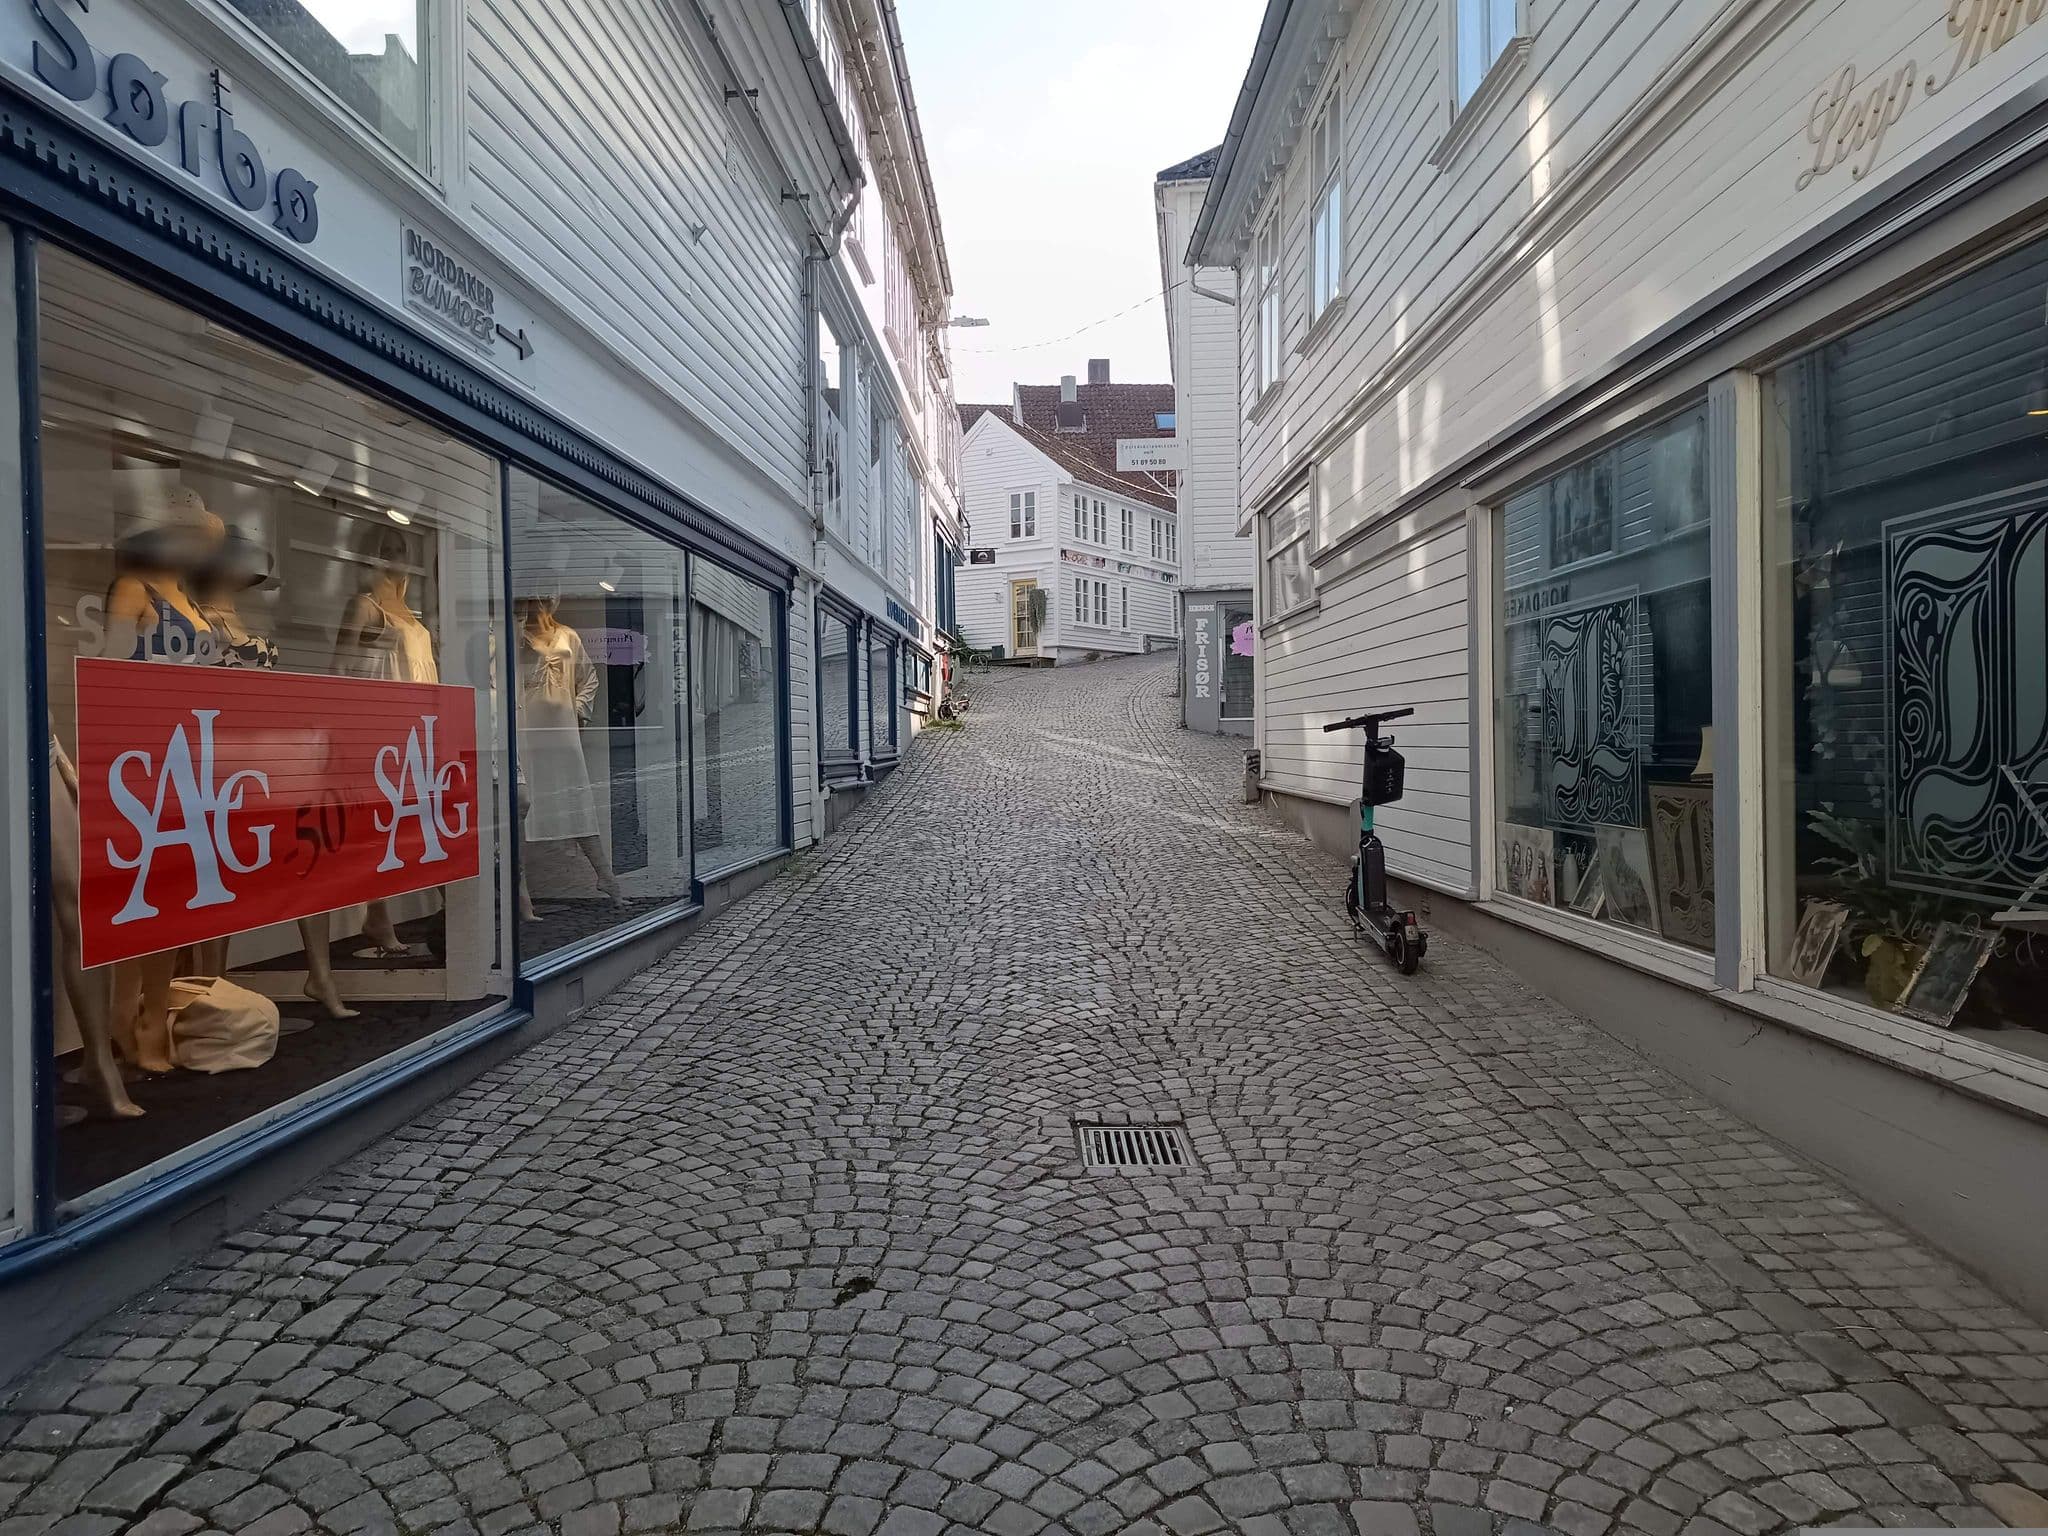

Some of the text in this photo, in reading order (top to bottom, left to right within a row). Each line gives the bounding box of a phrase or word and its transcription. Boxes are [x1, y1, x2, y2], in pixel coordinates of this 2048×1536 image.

[33, 0, 319, 244] Sørbø
[406, 228, 495, 315] NORDAKER
[409, 266, 496, 345] BUNADER
[1195, 618, 1210, 698] FRISØR
[106, 709, 275, 925] SALG
[373, 715, 470, 873] SALG
